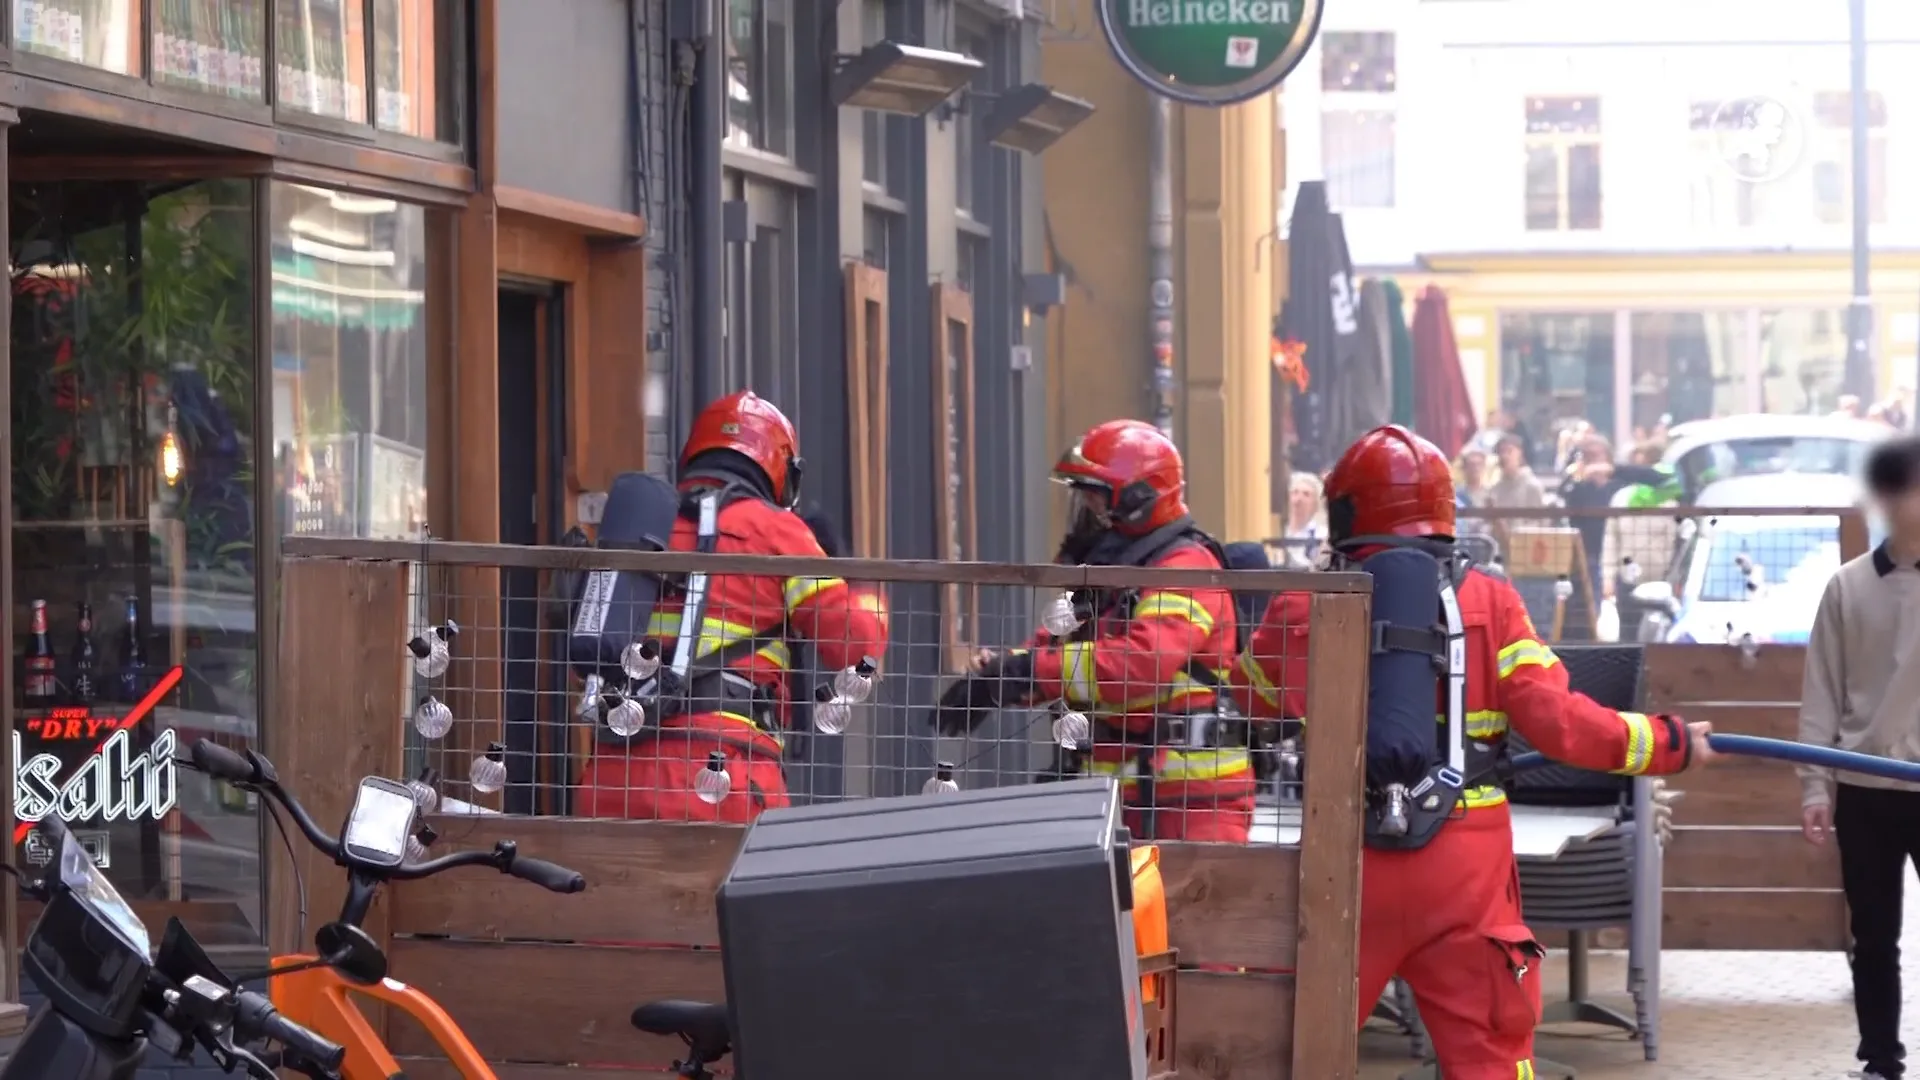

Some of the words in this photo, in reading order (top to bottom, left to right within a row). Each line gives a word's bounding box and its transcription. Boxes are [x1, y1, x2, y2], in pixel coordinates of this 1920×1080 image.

[1129, 0, 1291, 26] Heineken
[51, 708, 89, 719] SUPER
[12, 729, 176, 822] sahi
